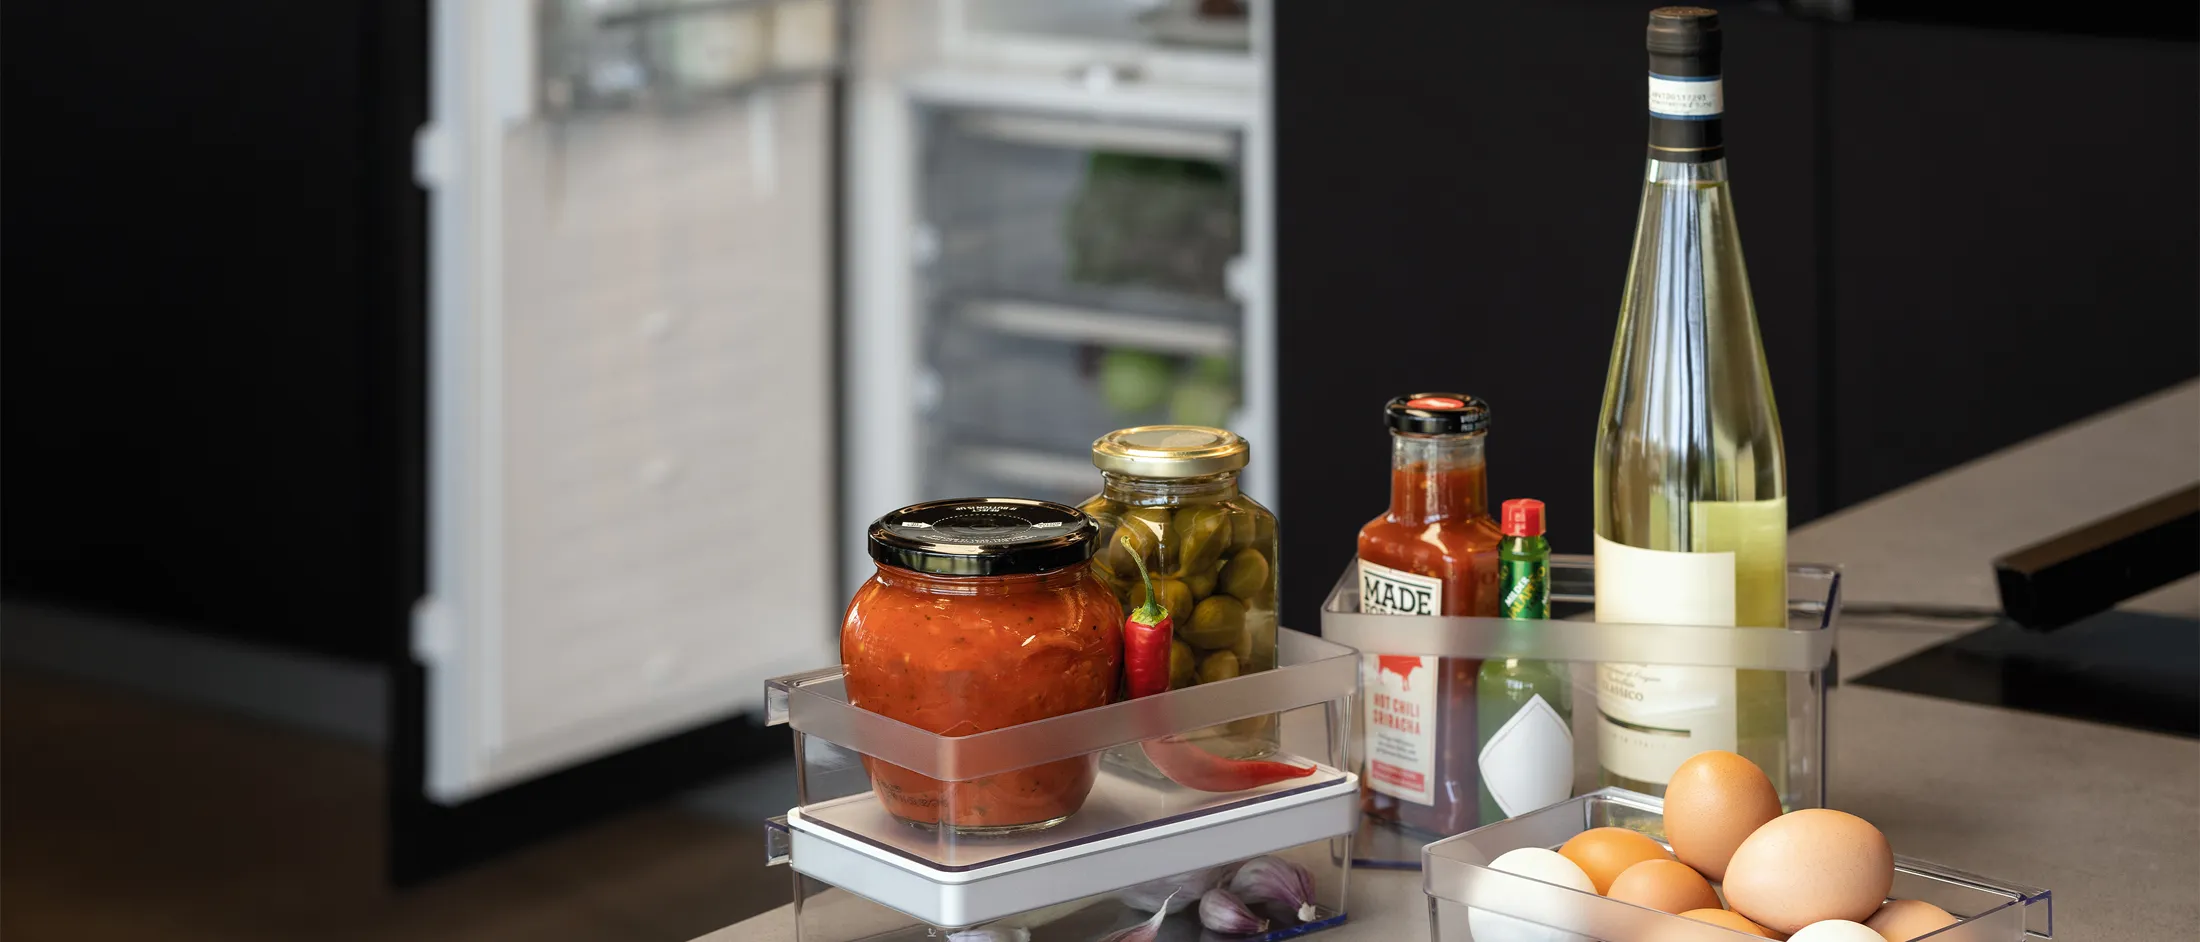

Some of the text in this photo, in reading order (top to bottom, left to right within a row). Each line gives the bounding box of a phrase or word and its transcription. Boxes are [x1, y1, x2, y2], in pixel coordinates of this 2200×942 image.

[1364, 576, 1432, 615] MADE
[1504, 576, 1531, 608] MILDER
[1373, 693, 1420, 717] HOT CHILI
[1373, 709, 1420, 734] SRIRACHA
